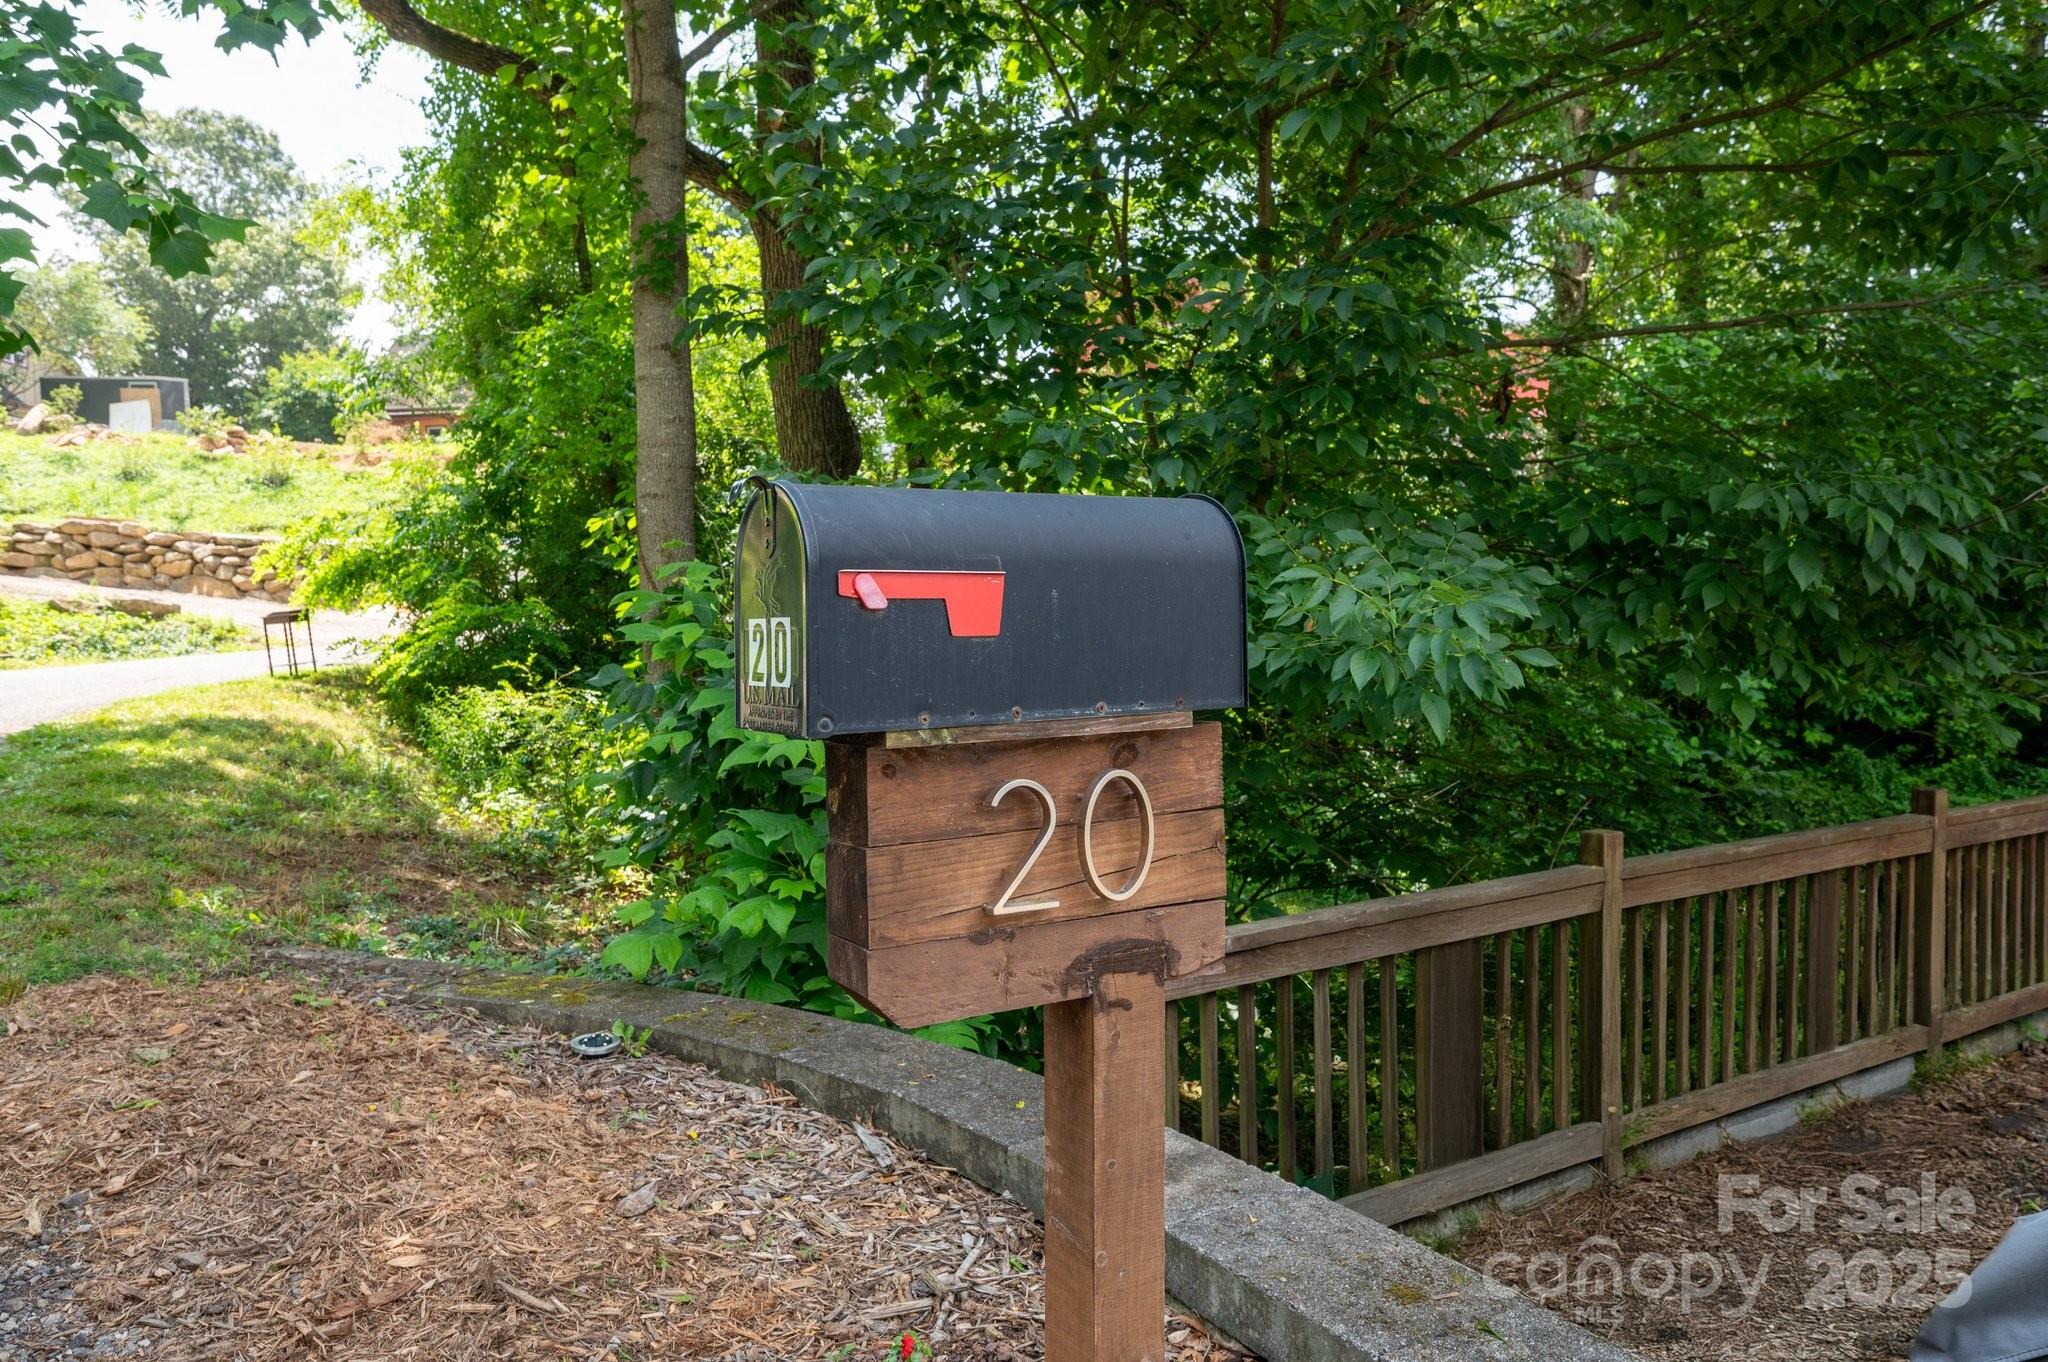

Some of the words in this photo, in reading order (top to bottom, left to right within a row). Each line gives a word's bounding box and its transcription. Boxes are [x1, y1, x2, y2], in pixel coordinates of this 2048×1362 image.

[751, 621, 788, 684] 20
[763, 683, 801, 709] MAIL
[984, 769, 1156, 916] 20
